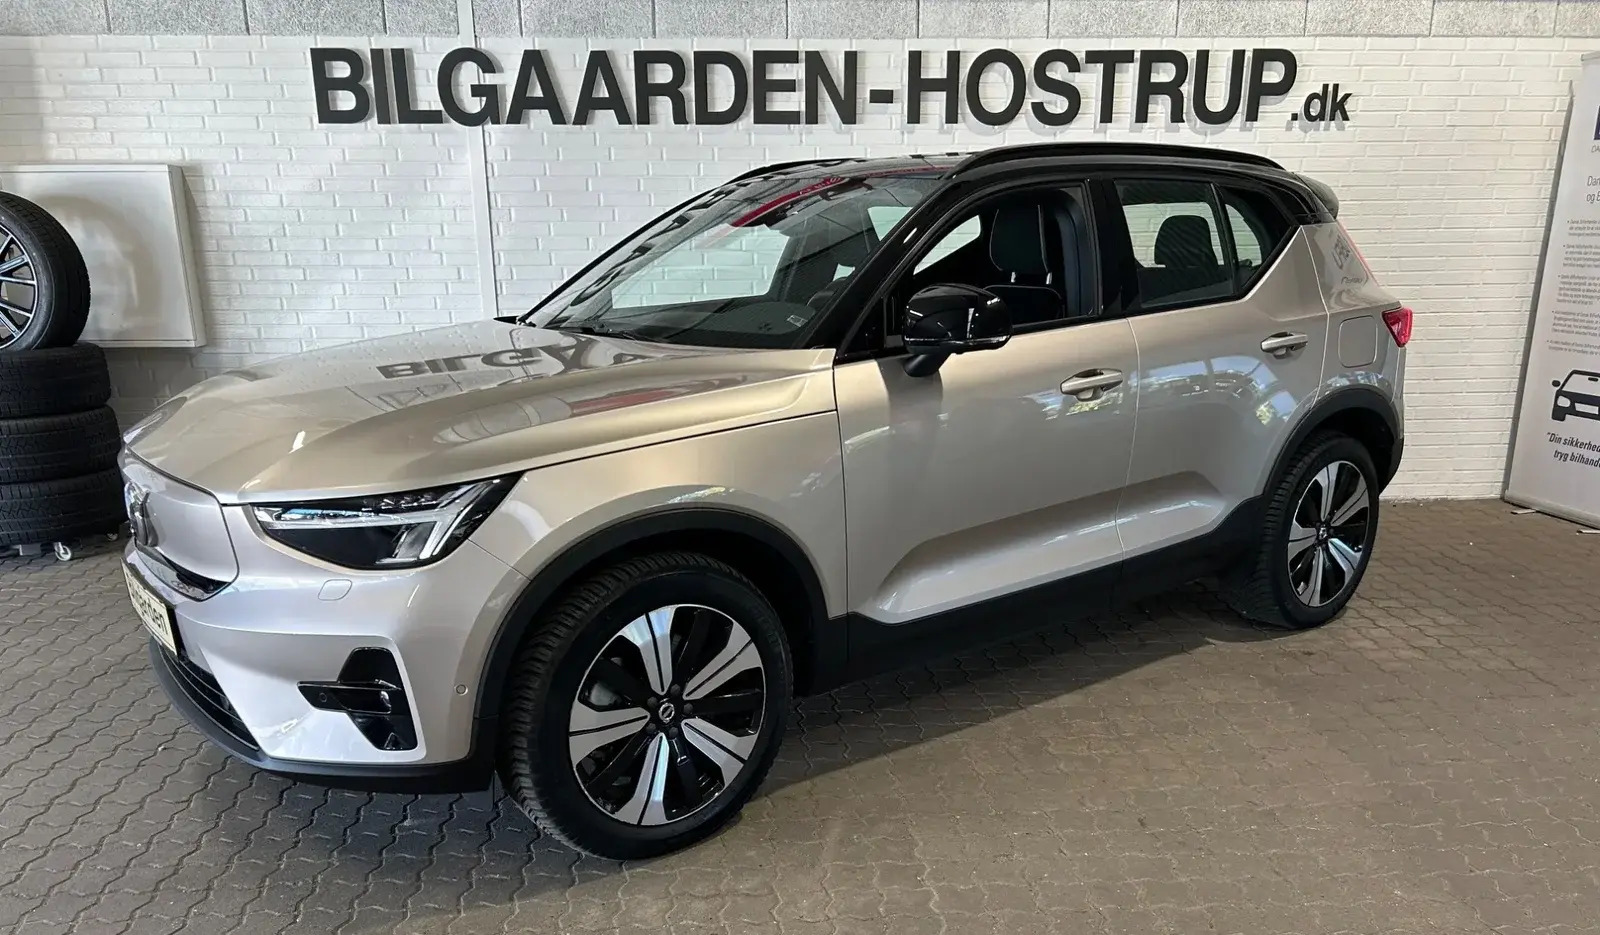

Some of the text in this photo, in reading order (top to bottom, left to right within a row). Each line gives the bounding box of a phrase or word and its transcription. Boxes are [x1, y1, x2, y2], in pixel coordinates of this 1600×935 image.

[1587, 193, 1595, 204] og
[1553, 449, 1600, 468] tryg bilhand
